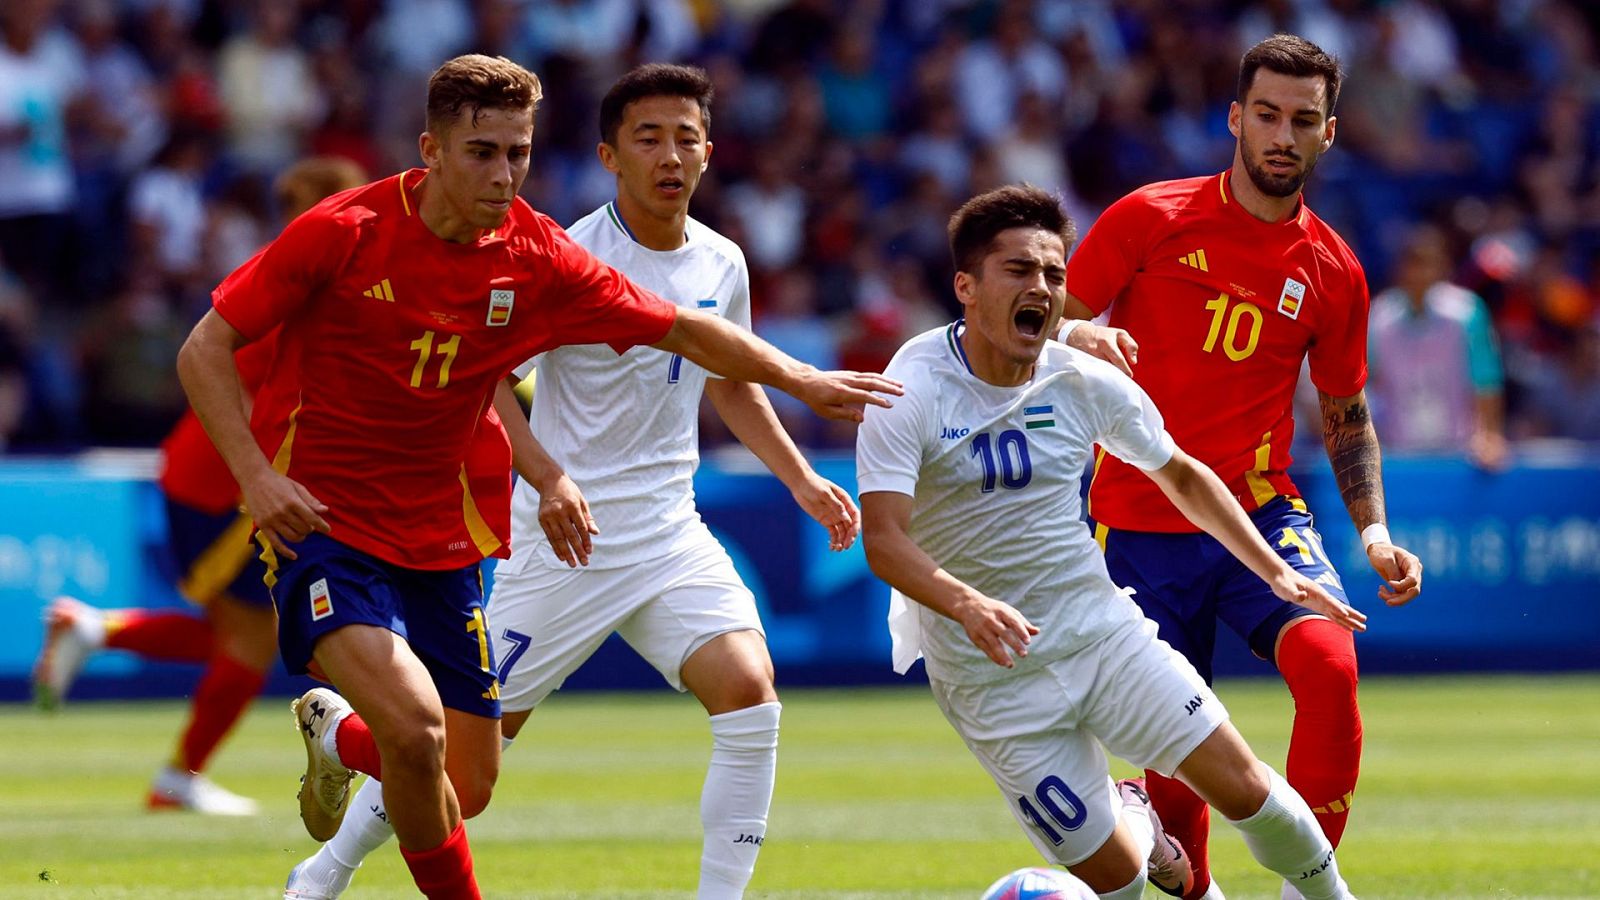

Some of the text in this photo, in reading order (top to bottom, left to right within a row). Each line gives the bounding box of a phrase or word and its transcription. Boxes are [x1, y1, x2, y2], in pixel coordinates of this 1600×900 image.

[1202, 291, 1264, 362] 10
[409, 330, 462, 389] 11
[969, 428, 1033, 494] 10
[497, 628, 532, 688] 7
[1184, 692, 1206, 716] JAK
[1017, 774, 1088, 847] 10
[1299, 850, 1333, 880] JAKO
